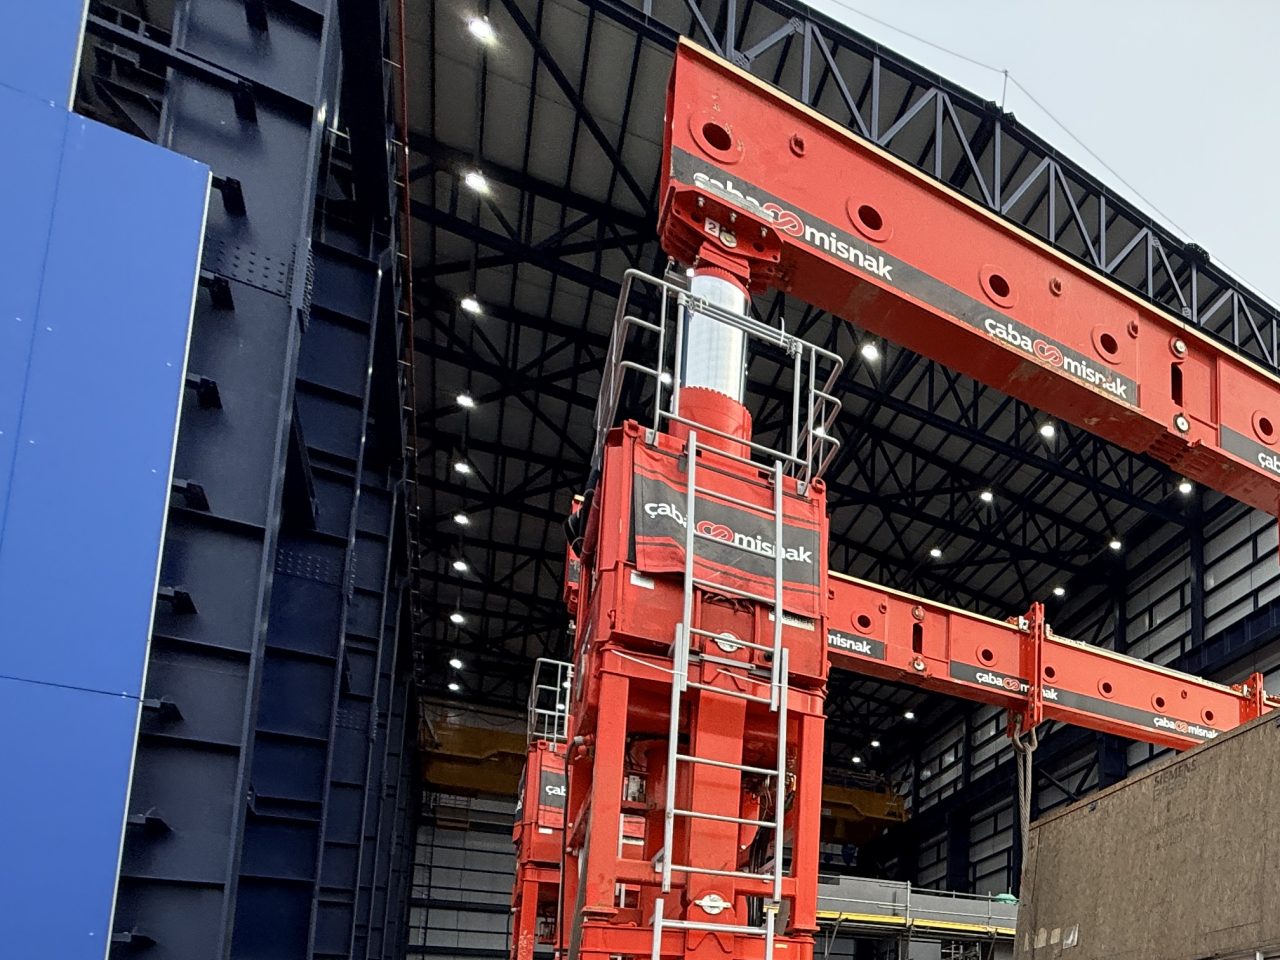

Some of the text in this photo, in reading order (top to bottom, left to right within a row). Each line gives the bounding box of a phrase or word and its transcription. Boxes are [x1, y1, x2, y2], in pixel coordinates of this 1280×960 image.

[804, 224, 893, 281] misnak
[984, 318, 1127, 399] çaba misnak
[644, 502, 690, 531] çab
[976, 672, 1004, 687] çaba
[1153, 716, 1176, 730] çaba
[1154, 759, 1197, 785] SIEMENS
